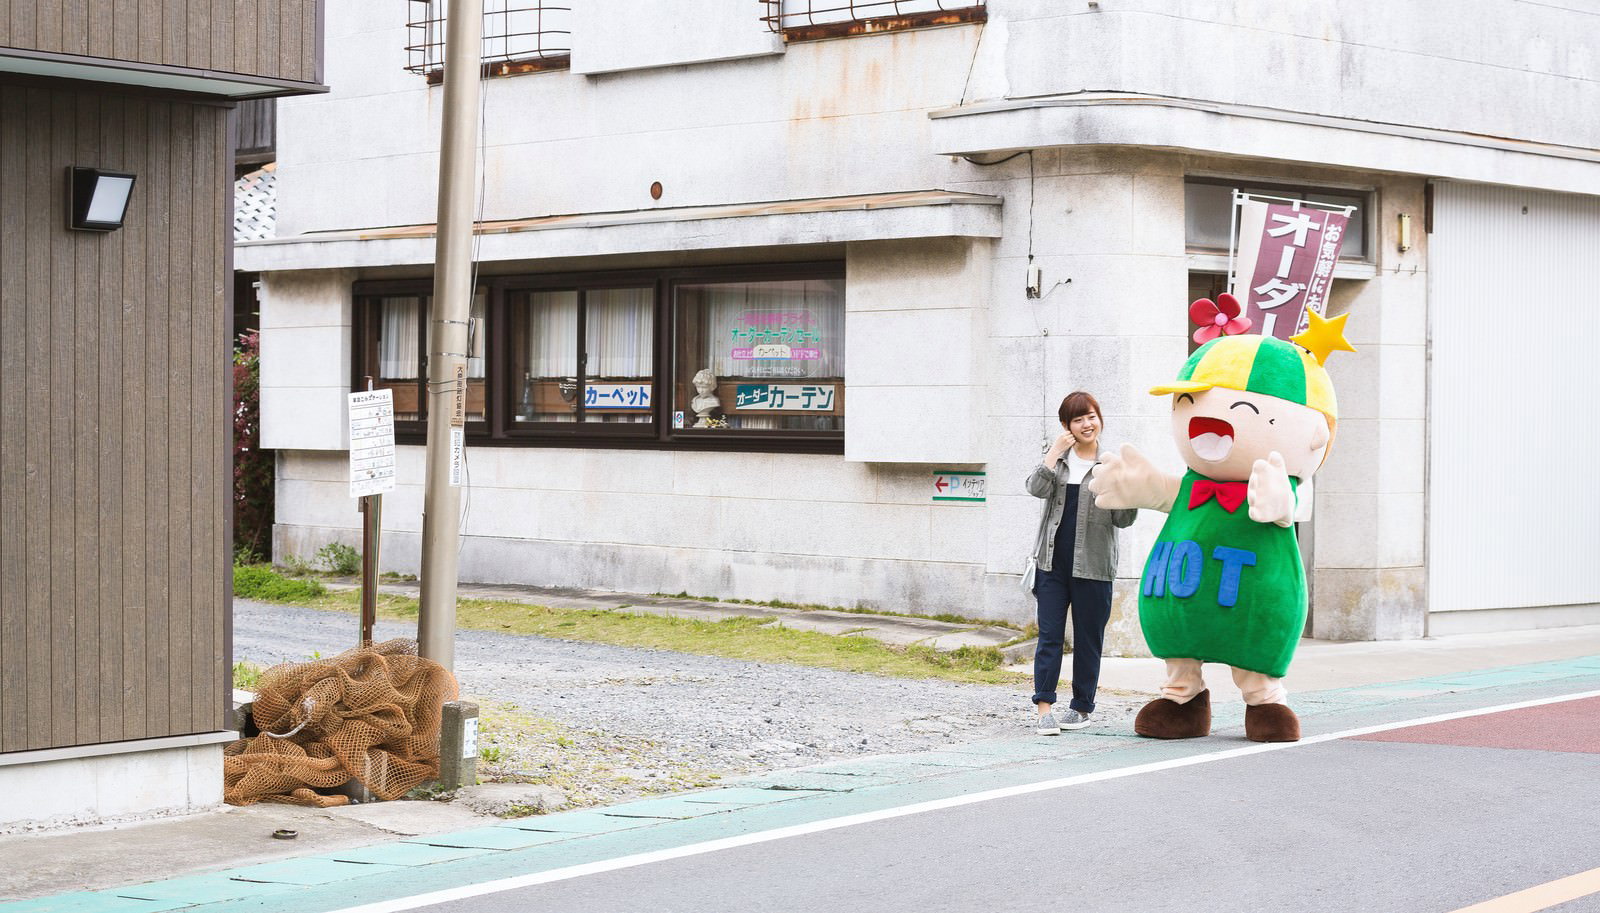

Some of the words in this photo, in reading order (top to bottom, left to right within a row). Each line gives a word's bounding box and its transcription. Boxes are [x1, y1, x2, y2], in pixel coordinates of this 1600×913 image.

[1253, 212, 1321, 337] オーダー
[585, 386, 649, 406] カーペット
[737, 388, 768, 406] オーダー
[769, 386, 833, 409] カーテン
[950, 476, 960, 493] P
[1143, 539, 1257, 608] HOT
